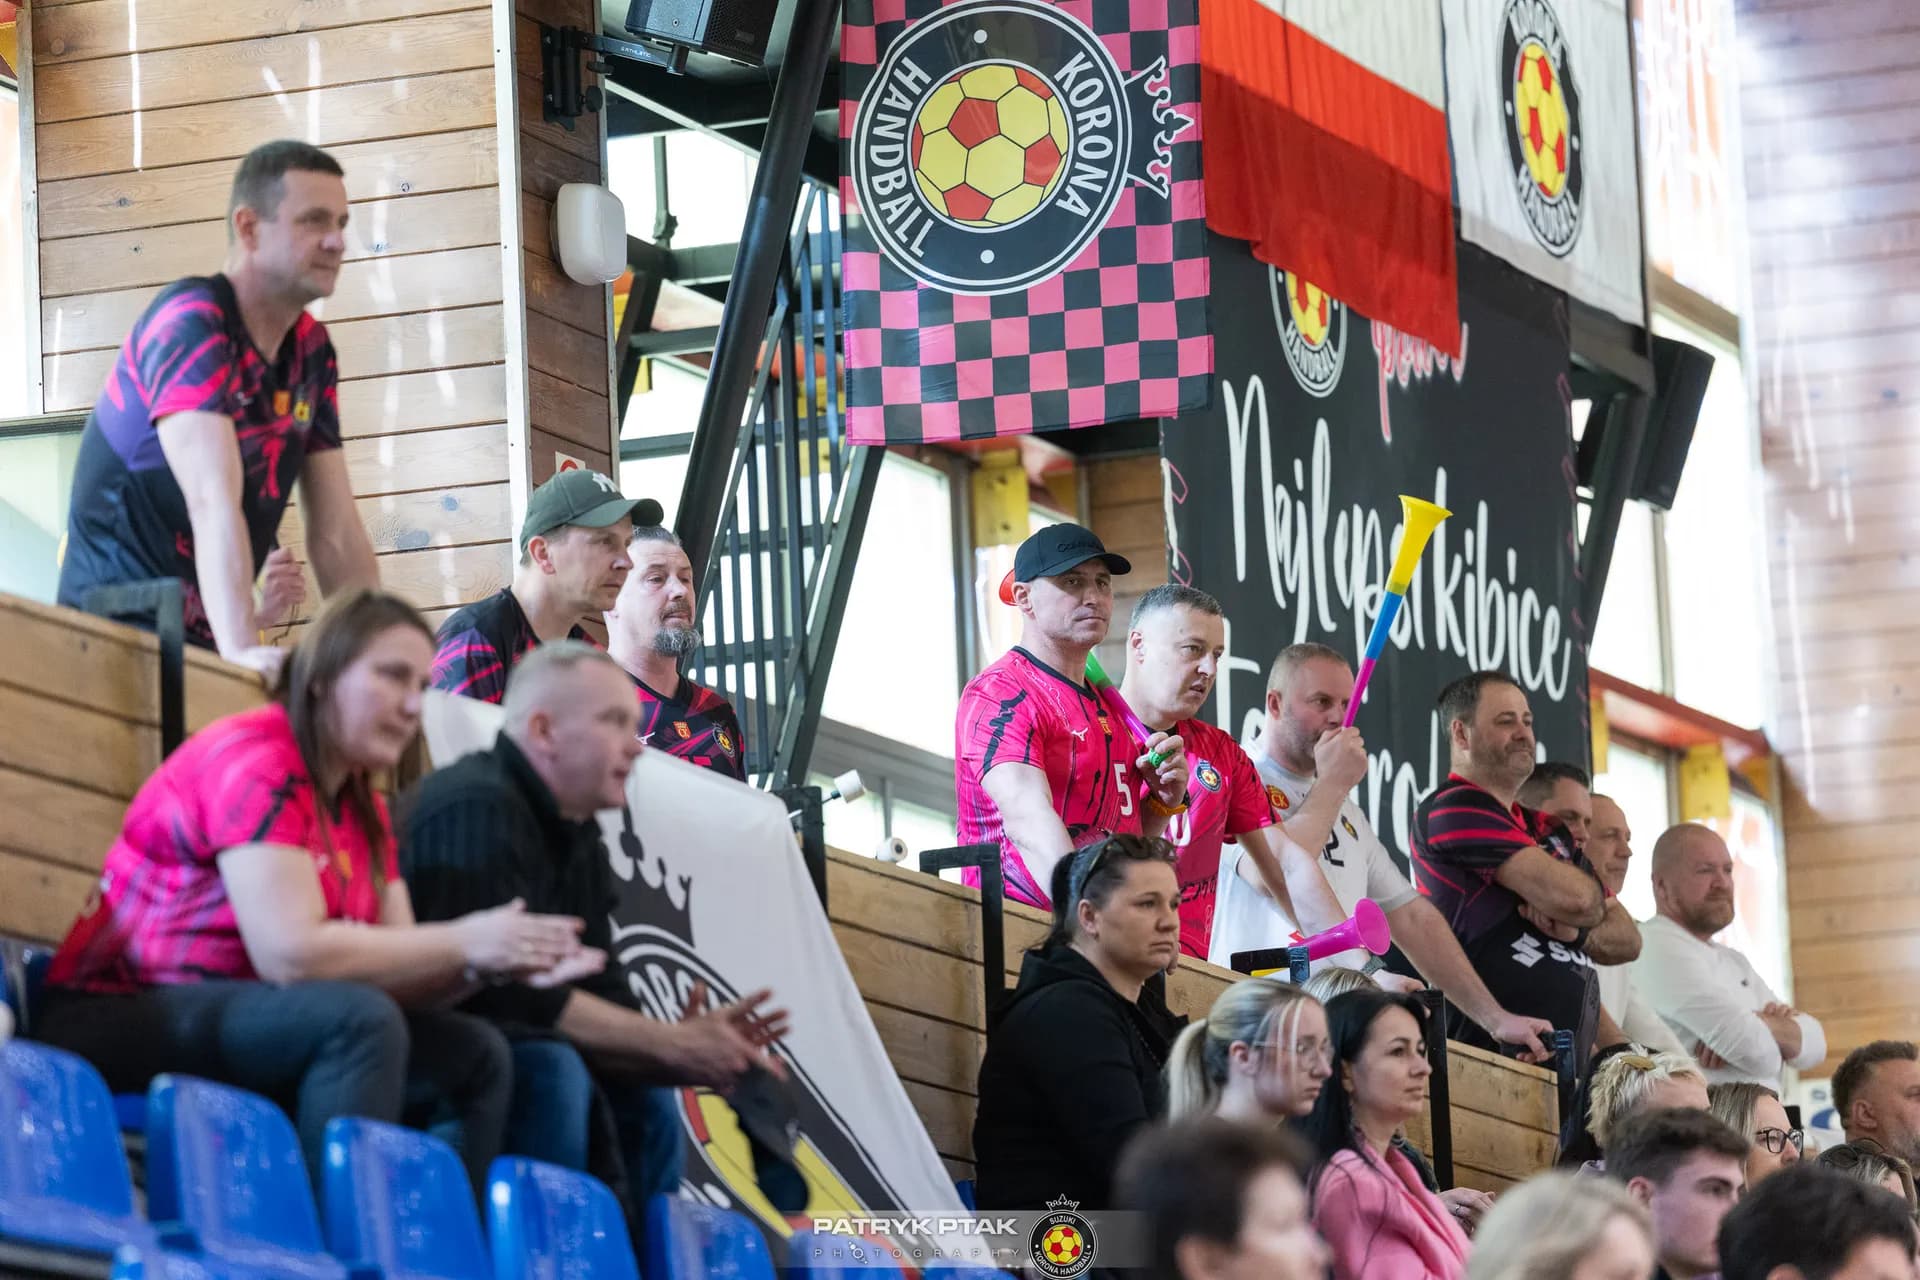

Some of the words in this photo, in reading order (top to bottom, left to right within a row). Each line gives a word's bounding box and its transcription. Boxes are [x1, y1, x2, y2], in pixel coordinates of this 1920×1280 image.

[870, 56, 934, 258] HANDBALL
[1053, 51, 1114, 218] KORONA
[1432, 466, 1572, 701] kibice
[1114, 763, 1133, 816] 5
